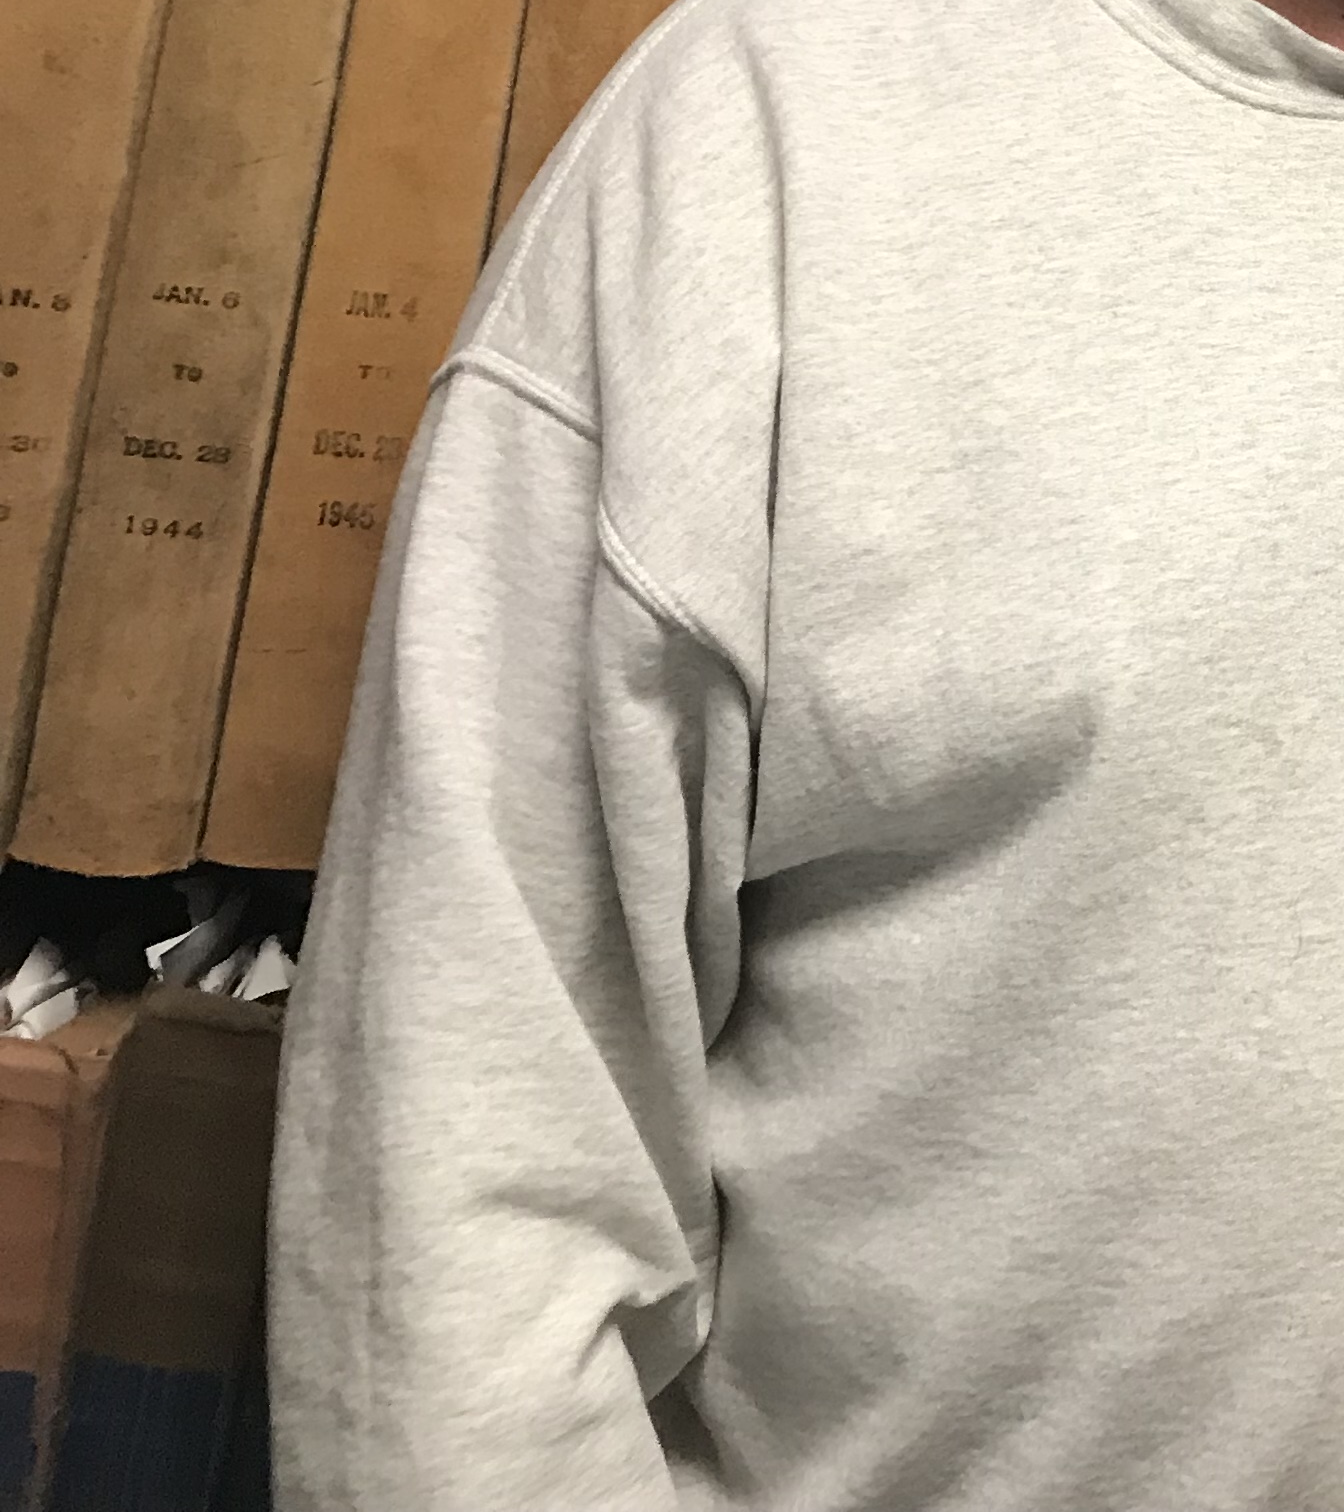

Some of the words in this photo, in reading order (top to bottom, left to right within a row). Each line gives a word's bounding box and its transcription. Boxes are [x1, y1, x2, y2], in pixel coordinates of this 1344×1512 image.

[152, 283, 211, 306] JAN.
[221, 291, 241, 310] 6
[345, 290, 391, 320] JAN.
[172, 363, 203, 382] TO
[122, 435, 183, 461] DEC.
[312, 428, 366, 459] DEC.
[124, 515, 205, 540] 1944
[316, 500, 378, 530] 1945
